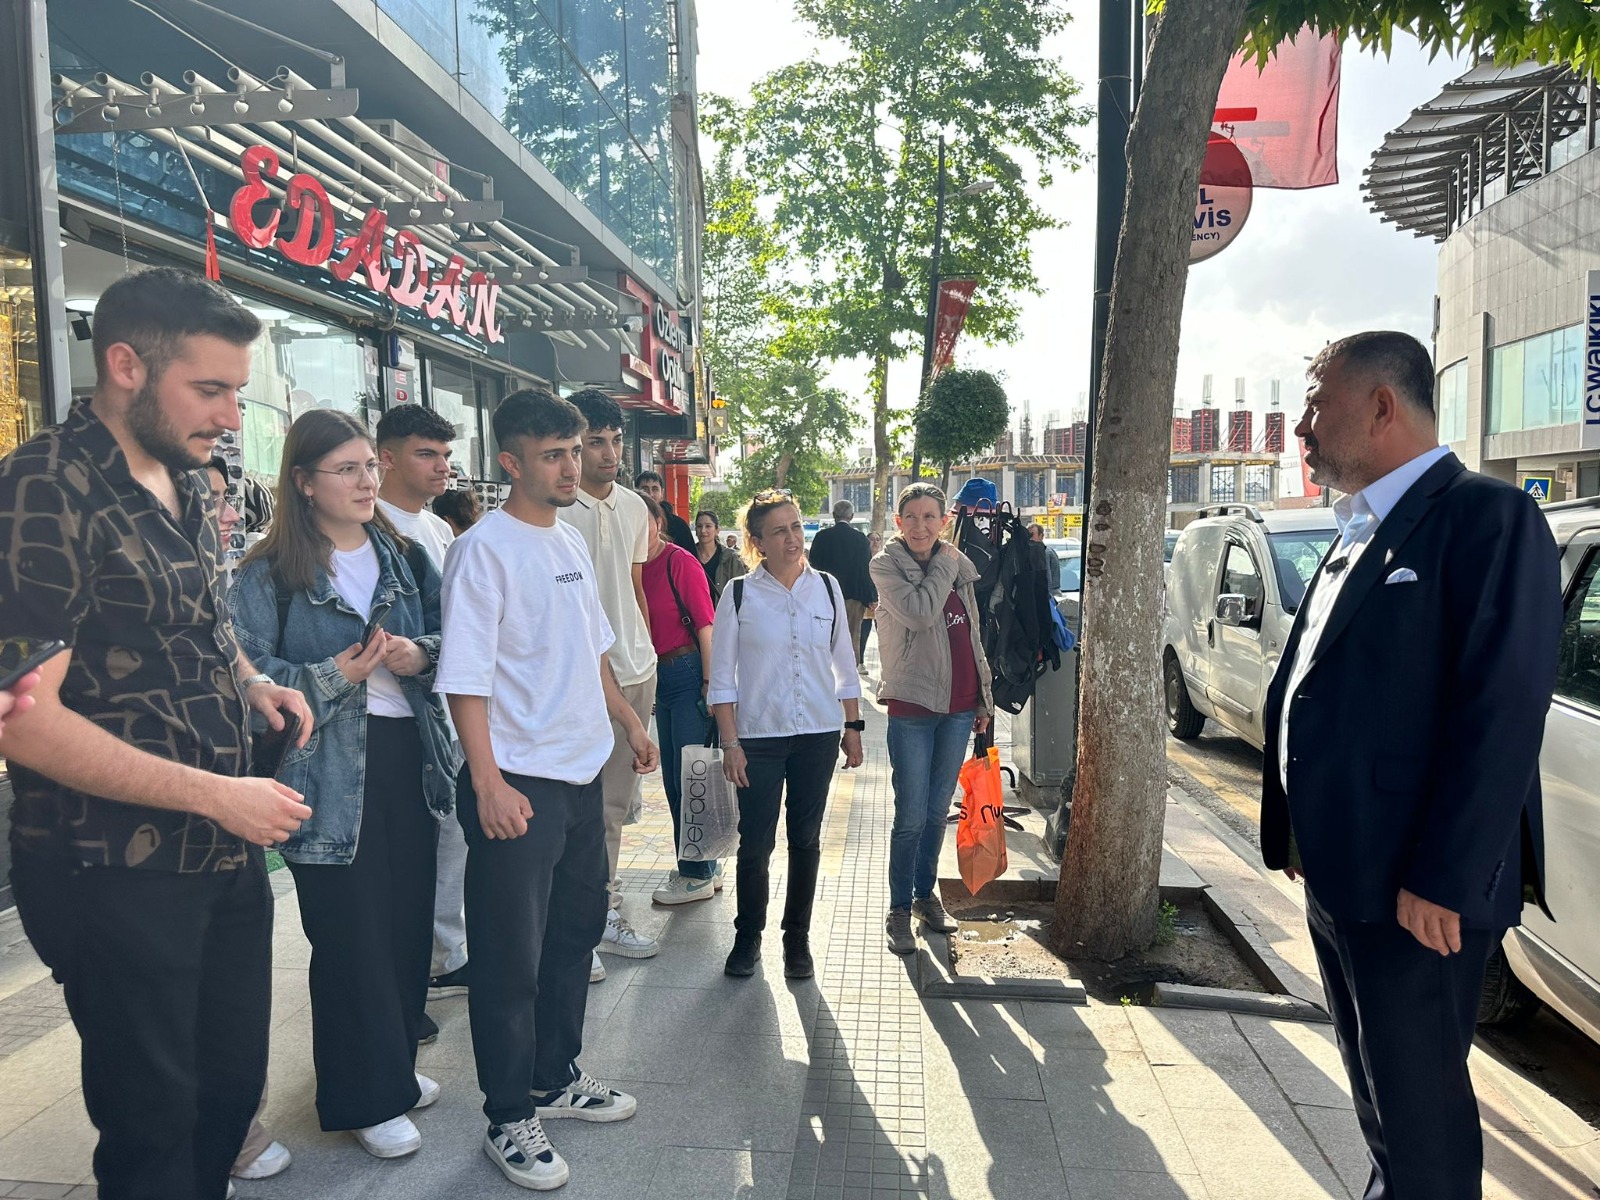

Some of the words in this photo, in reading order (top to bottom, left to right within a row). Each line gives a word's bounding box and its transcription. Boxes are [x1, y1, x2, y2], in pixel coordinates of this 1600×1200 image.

[230, 145, 504, 343] EDADAN
[1190, 231, 1220, 241] ENCY)
[555, 571, 583, 584] FREEDOM
[682, 759, 707, 859] DeFacto
